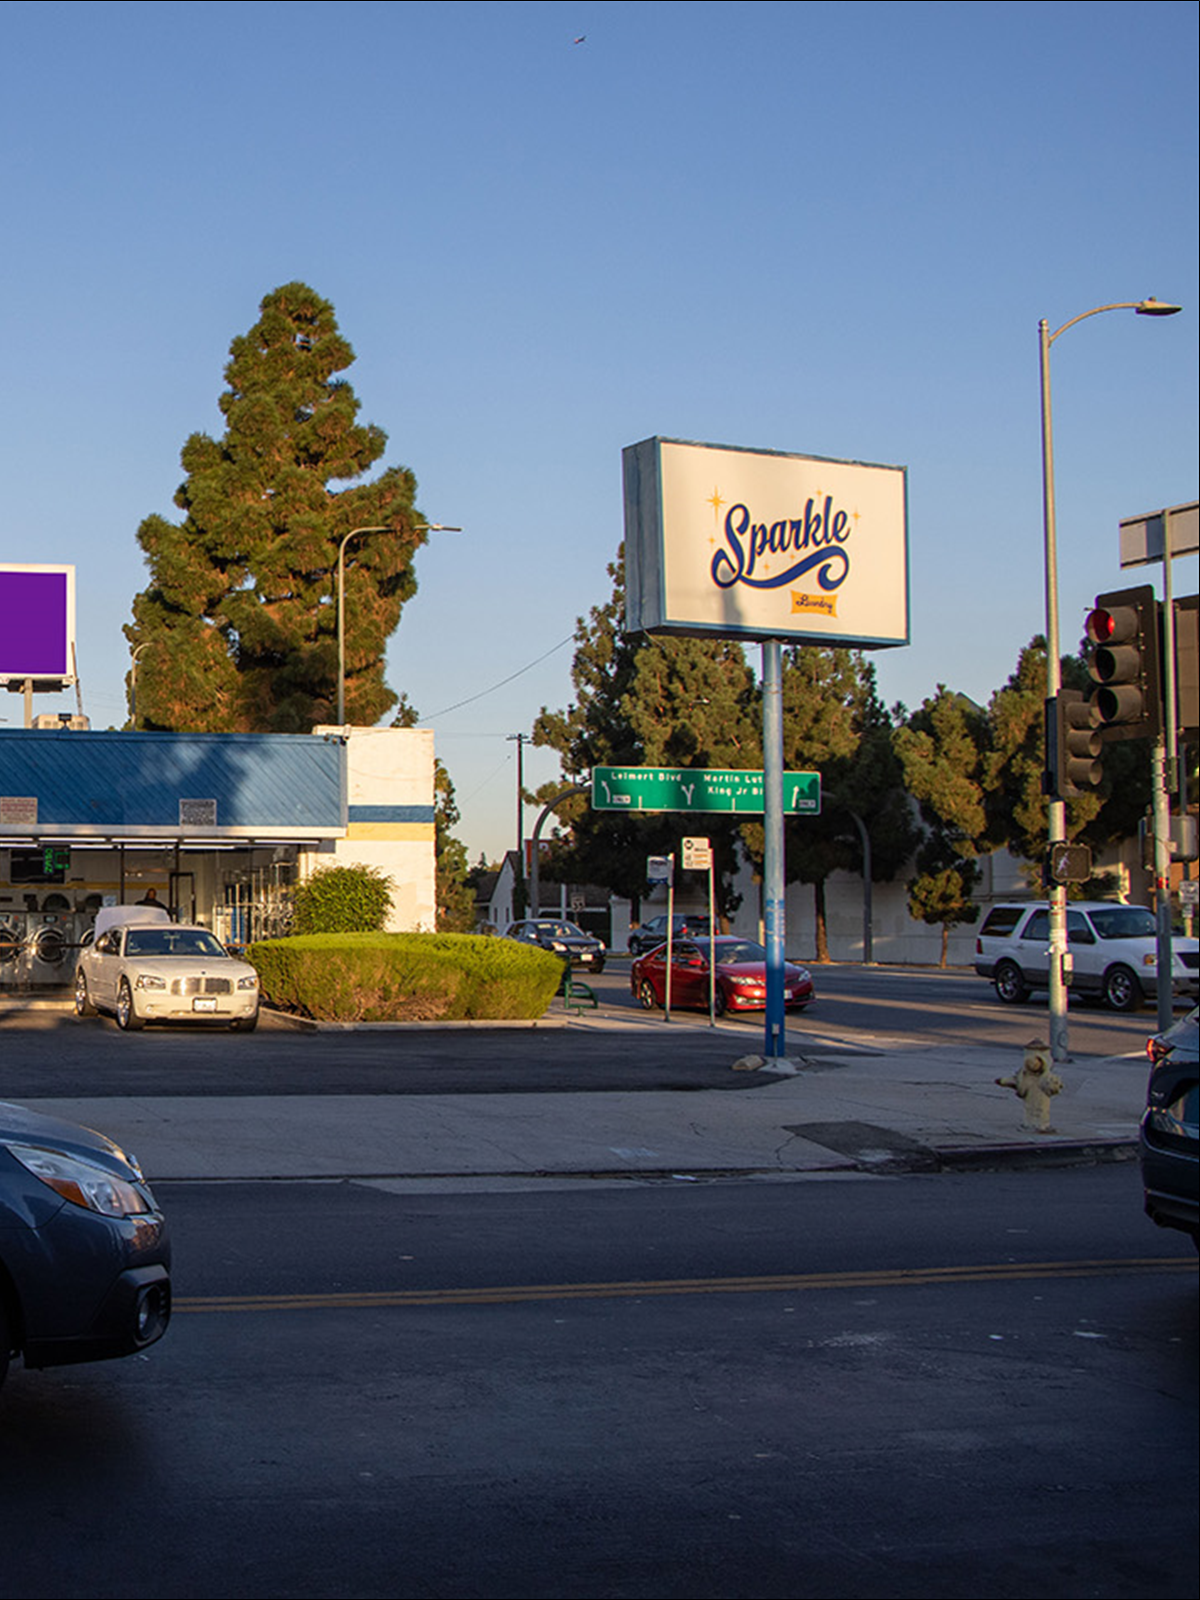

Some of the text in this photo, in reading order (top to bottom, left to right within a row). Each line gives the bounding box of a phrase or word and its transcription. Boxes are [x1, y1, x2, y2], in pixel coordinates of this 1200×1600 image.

[711, 495, 851, 591] Sparkle
[611, 771, 682, 782] Leimert Blvd
[703, 774, 740, 784] Martin
[707, 786, 732, 797] King
[736, 786, 747, 796] Jr
